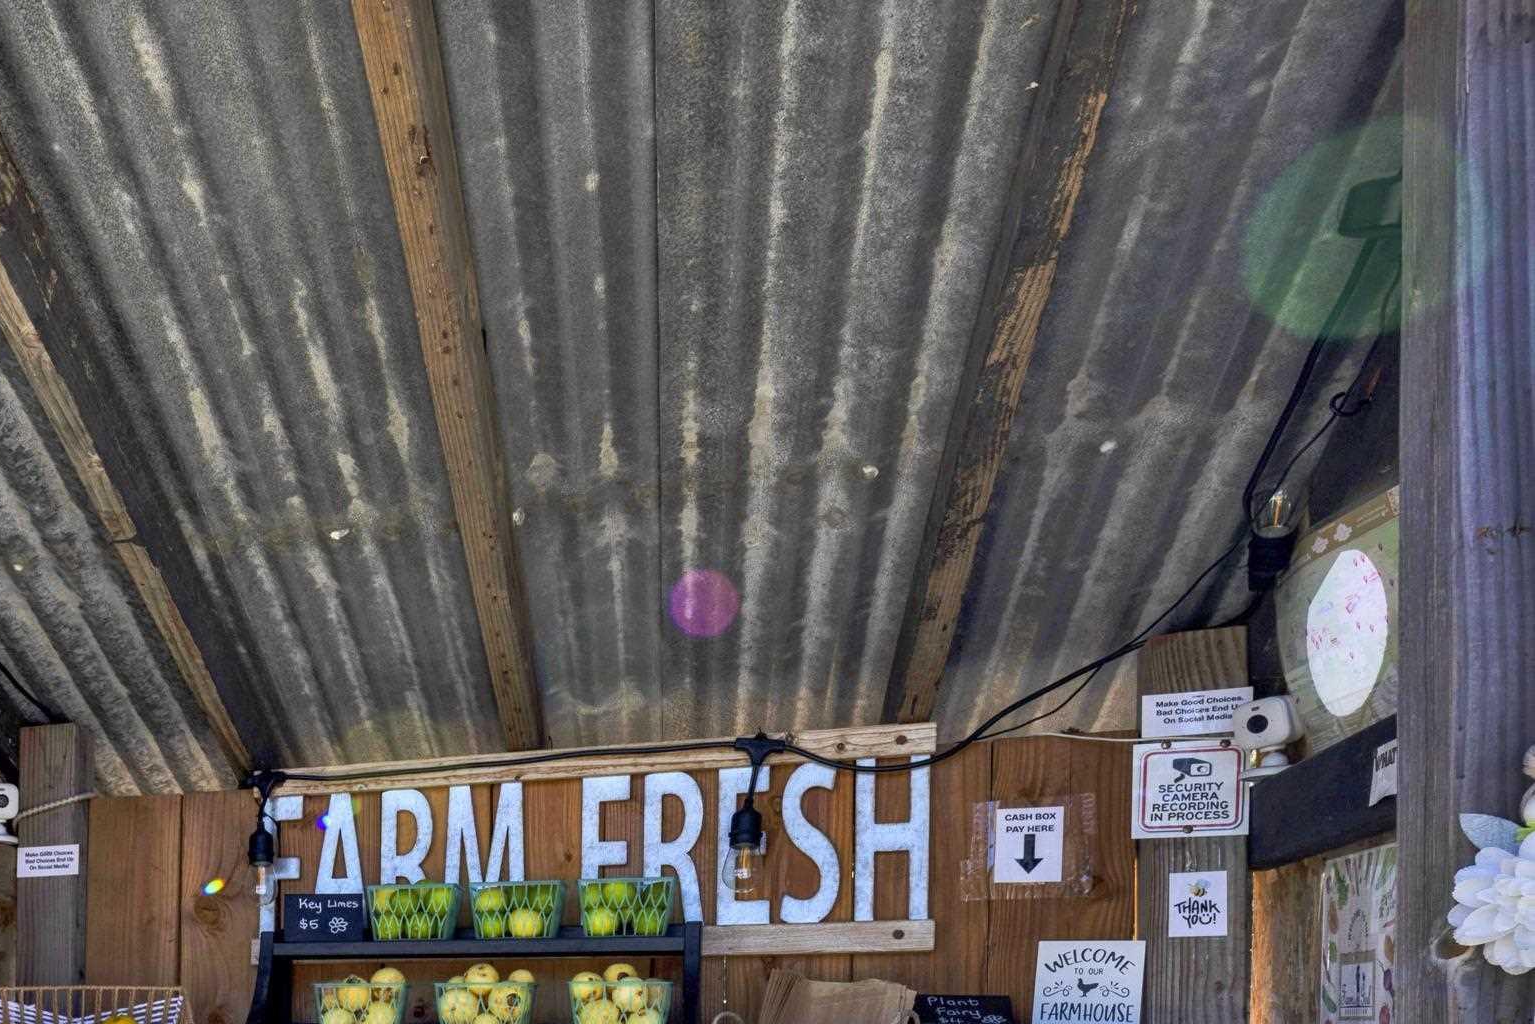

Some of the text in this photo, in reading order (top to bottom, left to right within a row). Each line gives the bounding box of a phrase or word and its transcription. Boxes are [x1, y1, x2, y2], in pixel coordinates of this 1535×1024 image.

[1212, 704, 1229, 712] End
[1178, 715, 1205, 723] Social
[1158, 781, 1224, 793] SECURITY
[1162, 792, 1219, 802] CAMERA
[1152, 800, 1229, 812] RECORDING
[1035, 812, 1056, 820] BOX
[1150, 810, 1230, 822] IN PROCESS
[298, 898, 322, 914] Key
[1174, 897, 1221, 914] THANK
[299, 918, 319, 930] $5
[1044, 948, 1136, 975] WELCOME
[1074, 967, 1084, 975] TO
[927, 996, 979, 1006] Plant
[936, 1007, 981, 1019] Fairy
[1040, 1001, 1135, 1023] FARMHOUSE
